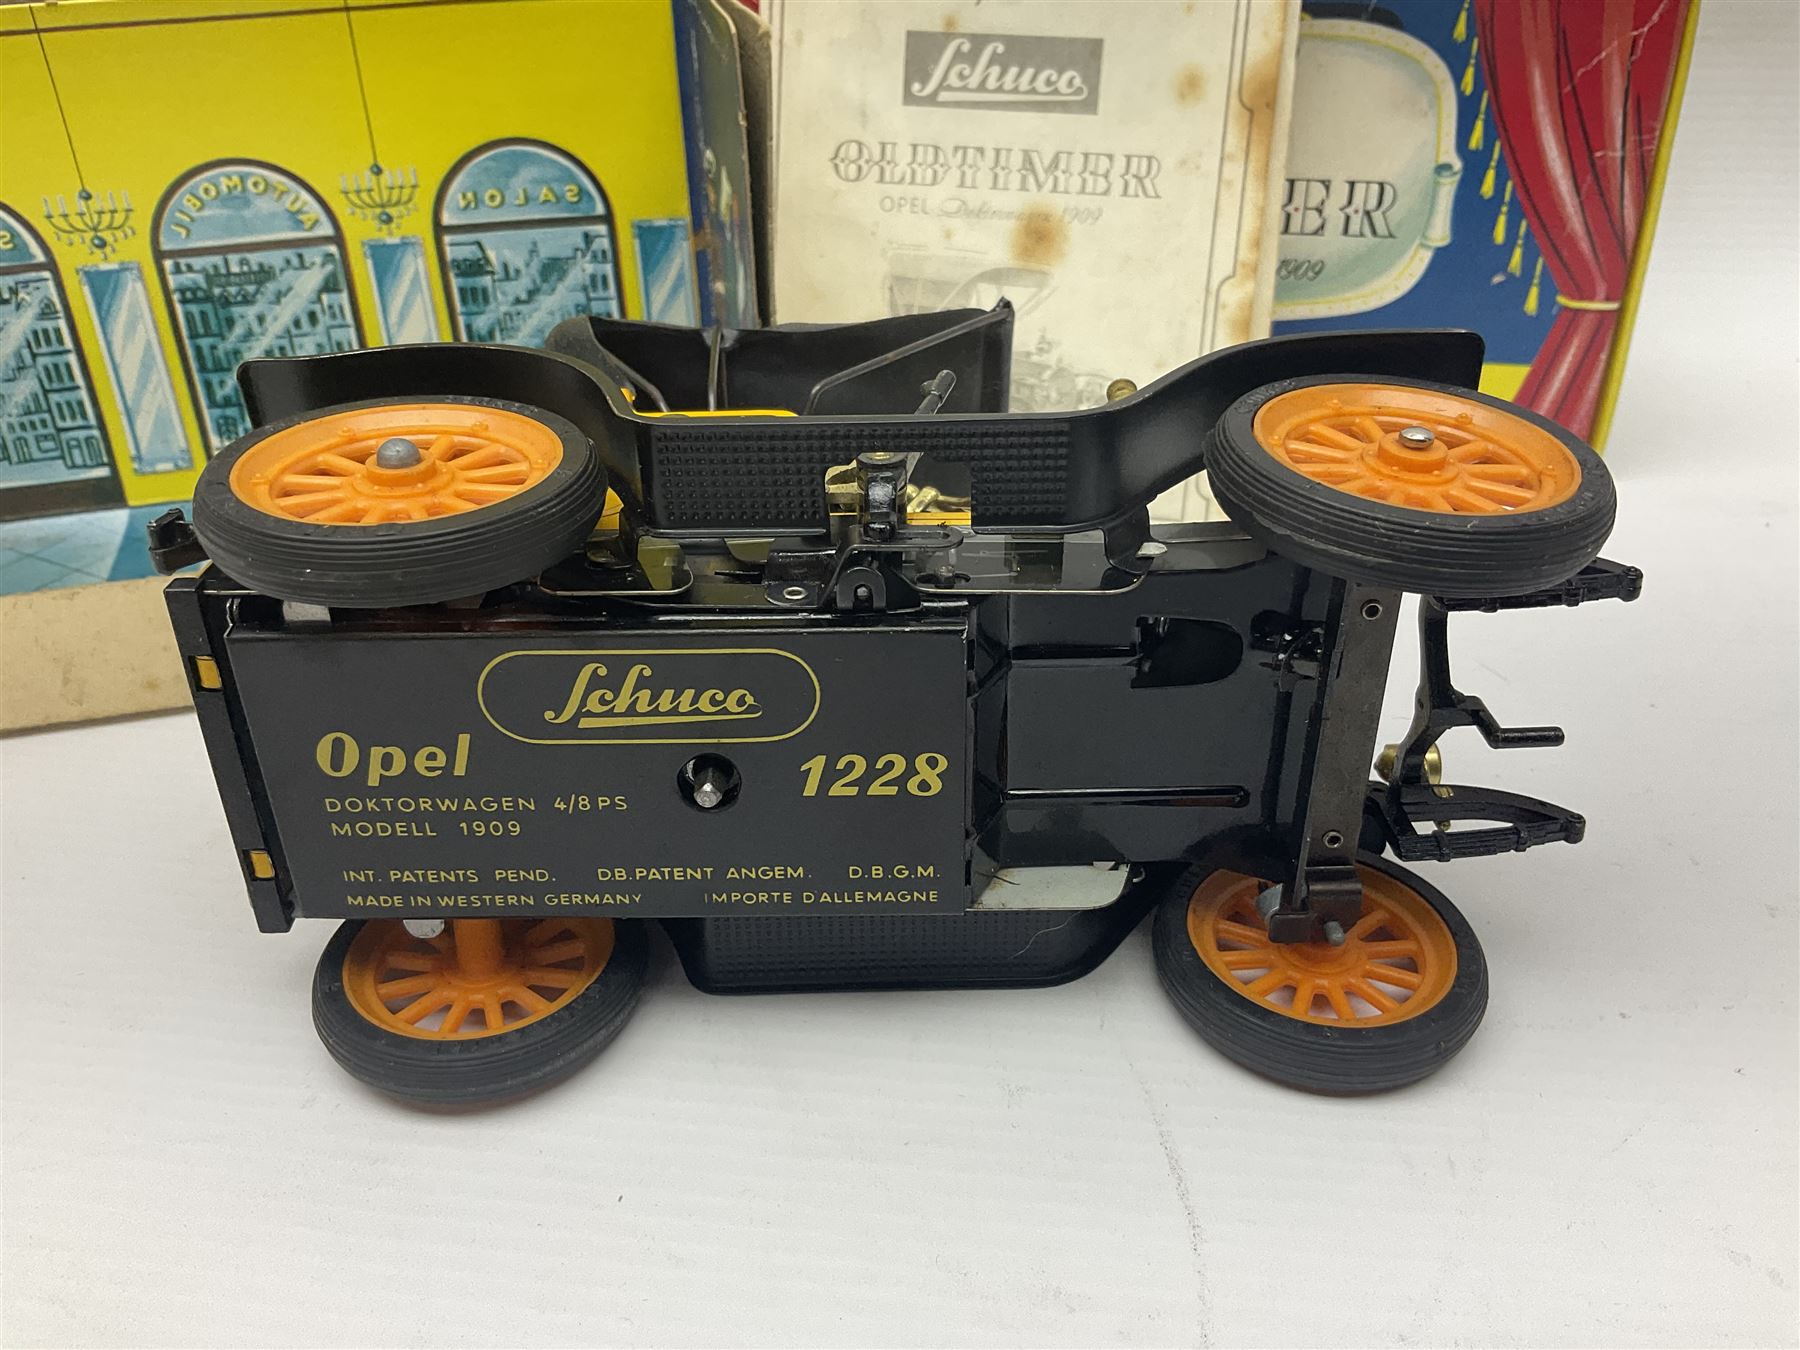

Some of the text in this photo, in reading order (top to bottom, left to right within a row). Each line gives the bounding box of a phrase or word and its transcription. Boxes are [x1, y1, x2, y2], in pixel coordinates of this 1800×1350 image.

[911, 38, 1088, 102] Schuco
[830, 139, 1162, 199] OLDTIMER
[879, 196, 931, 216] OPEL
[543, 663, 763, 729] Schuco
[316, 731, 471, 787] Opel
[800, 752, 949, 797] 1228
[325, 793, 628, 814] DOKTORWAGEN 4/8 PS
[331, 820, 521, 837] MODELL 1909
[343, 869, 556, 883] INT. PATENTS PEND.
[726, 866, 812, 880] ANGEM.
[848, 864, 941, 879] D.B.G.M.
[347, 893, 642, 907] MADE IN WESTERN GERMANY
[704, 892, 792, 905] IMPORTE
